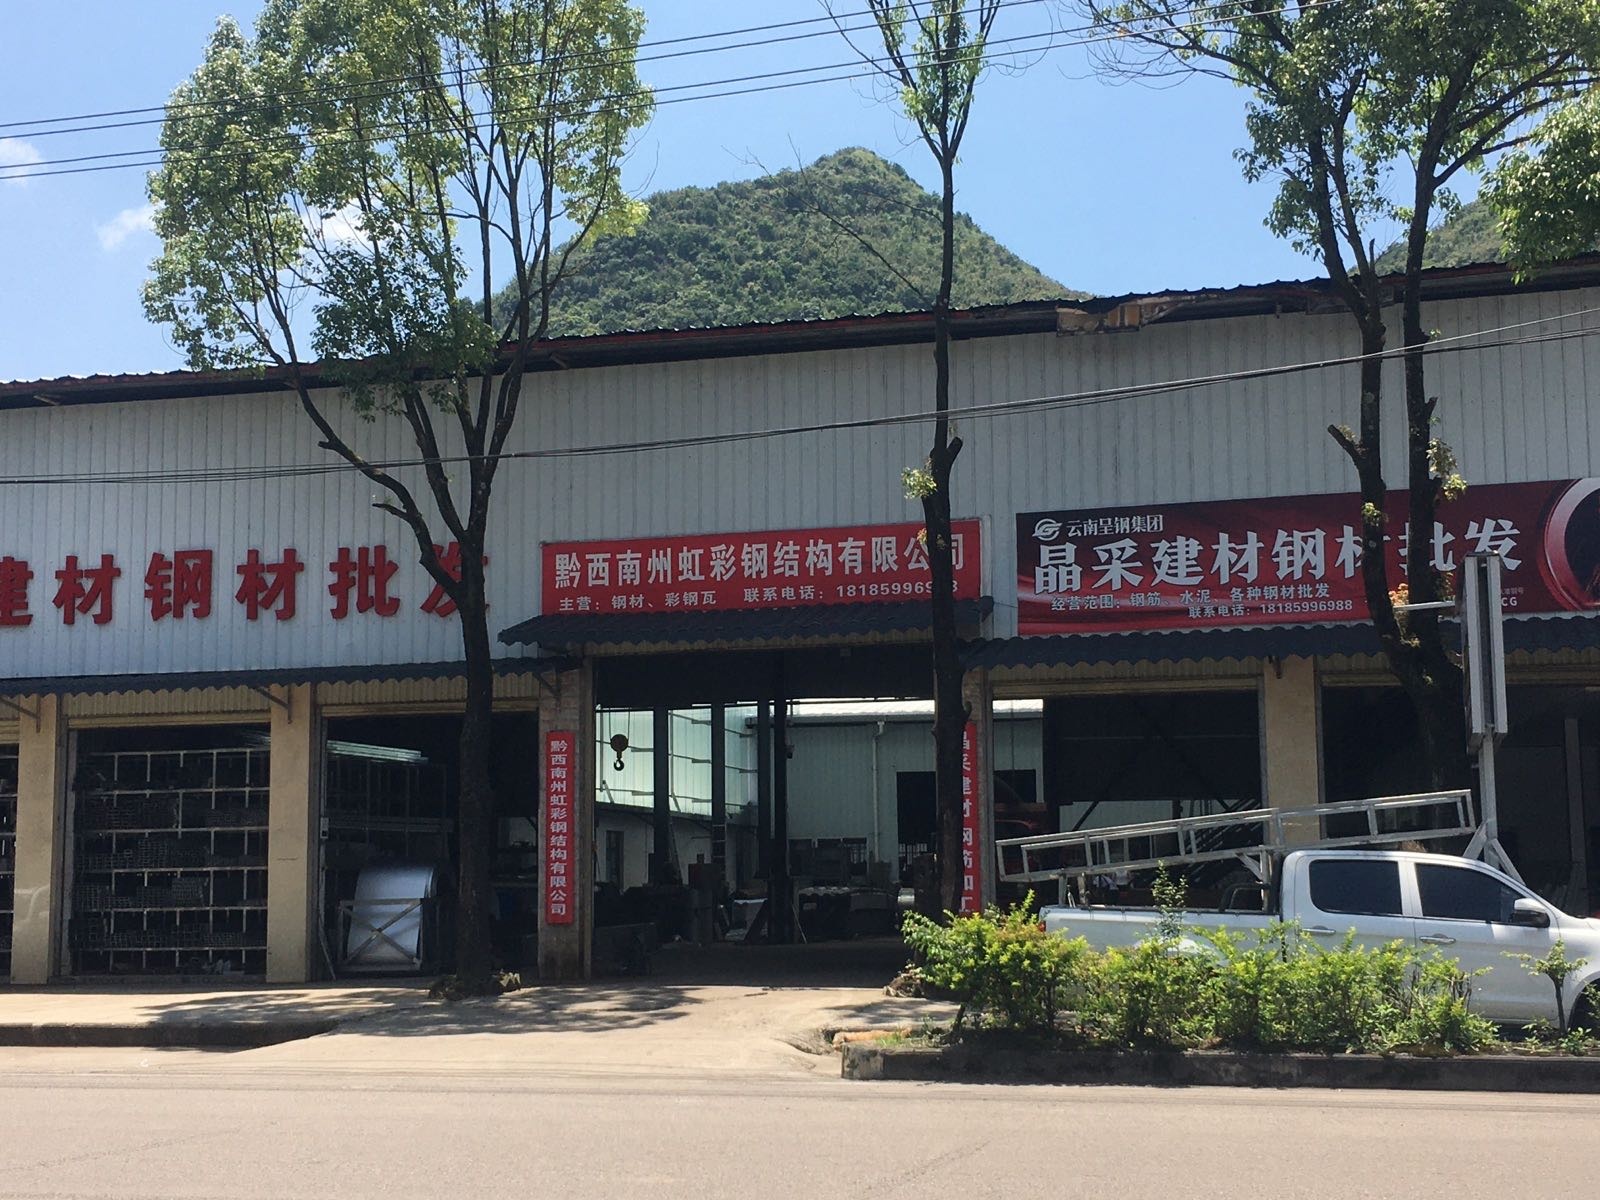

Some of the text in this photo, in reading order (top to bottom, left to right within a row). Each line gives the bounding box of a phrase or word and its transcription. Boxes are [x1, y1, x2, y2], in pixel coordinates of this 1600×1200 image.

[1066, 514, 1163, 537] 云南呈钢集团
[550, 740, 568, 916] 黔西南州虹彩钢结构有限公司
